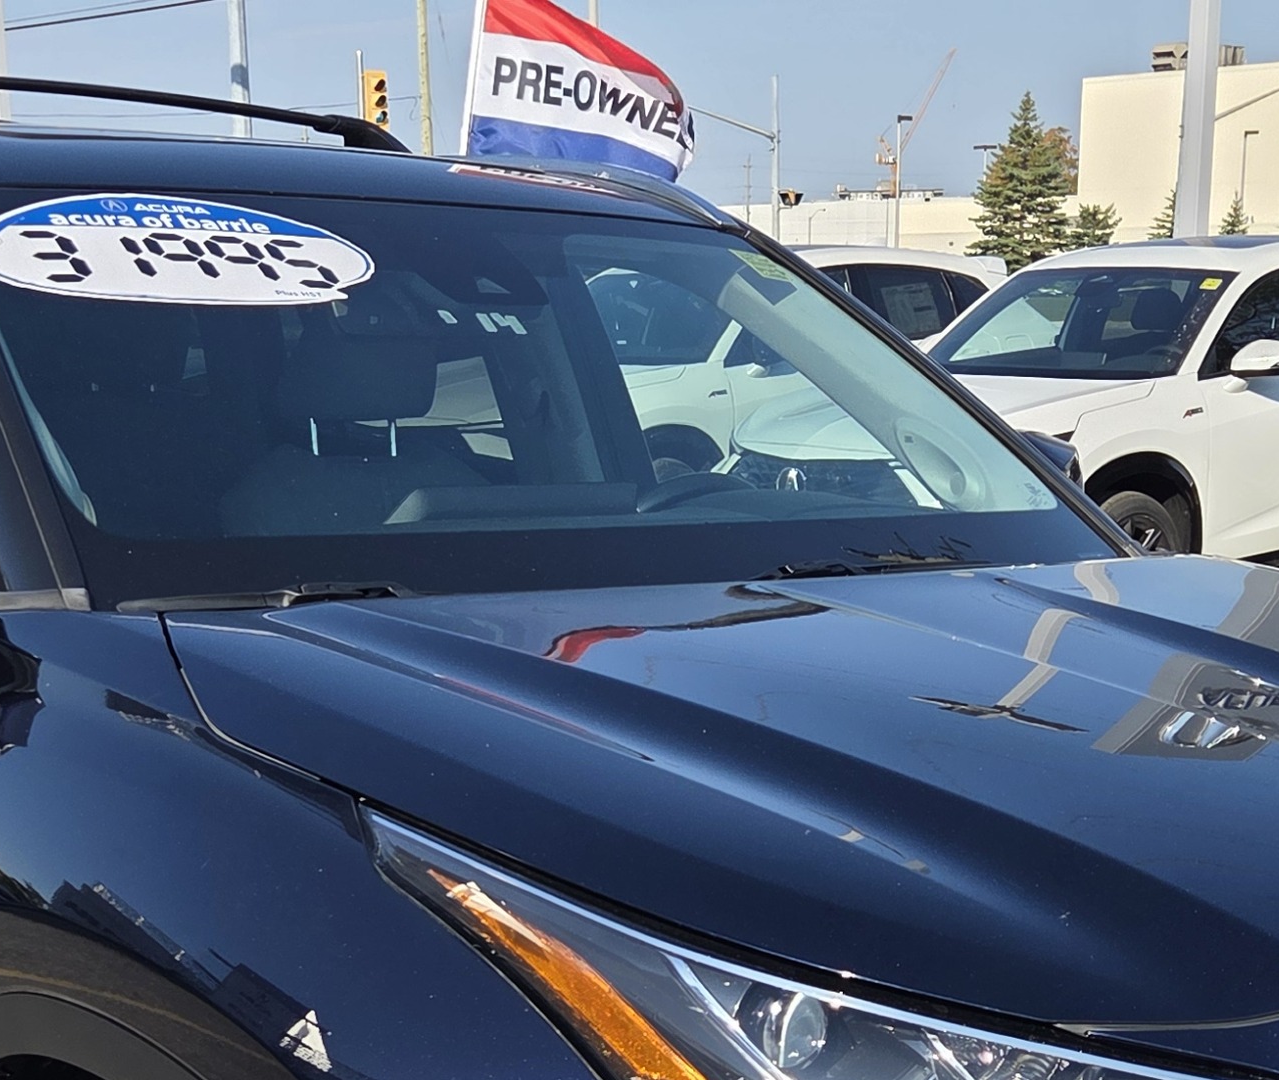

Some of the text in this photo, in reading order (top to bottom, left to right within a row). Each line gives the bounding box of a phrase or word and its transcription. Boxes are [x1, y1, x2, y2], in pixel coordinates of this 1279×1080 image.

[134, 203, 211, 215] ACURA
[48, 213, 271, 234] acura of barrie
[19, 230, 340, 290] 31995
